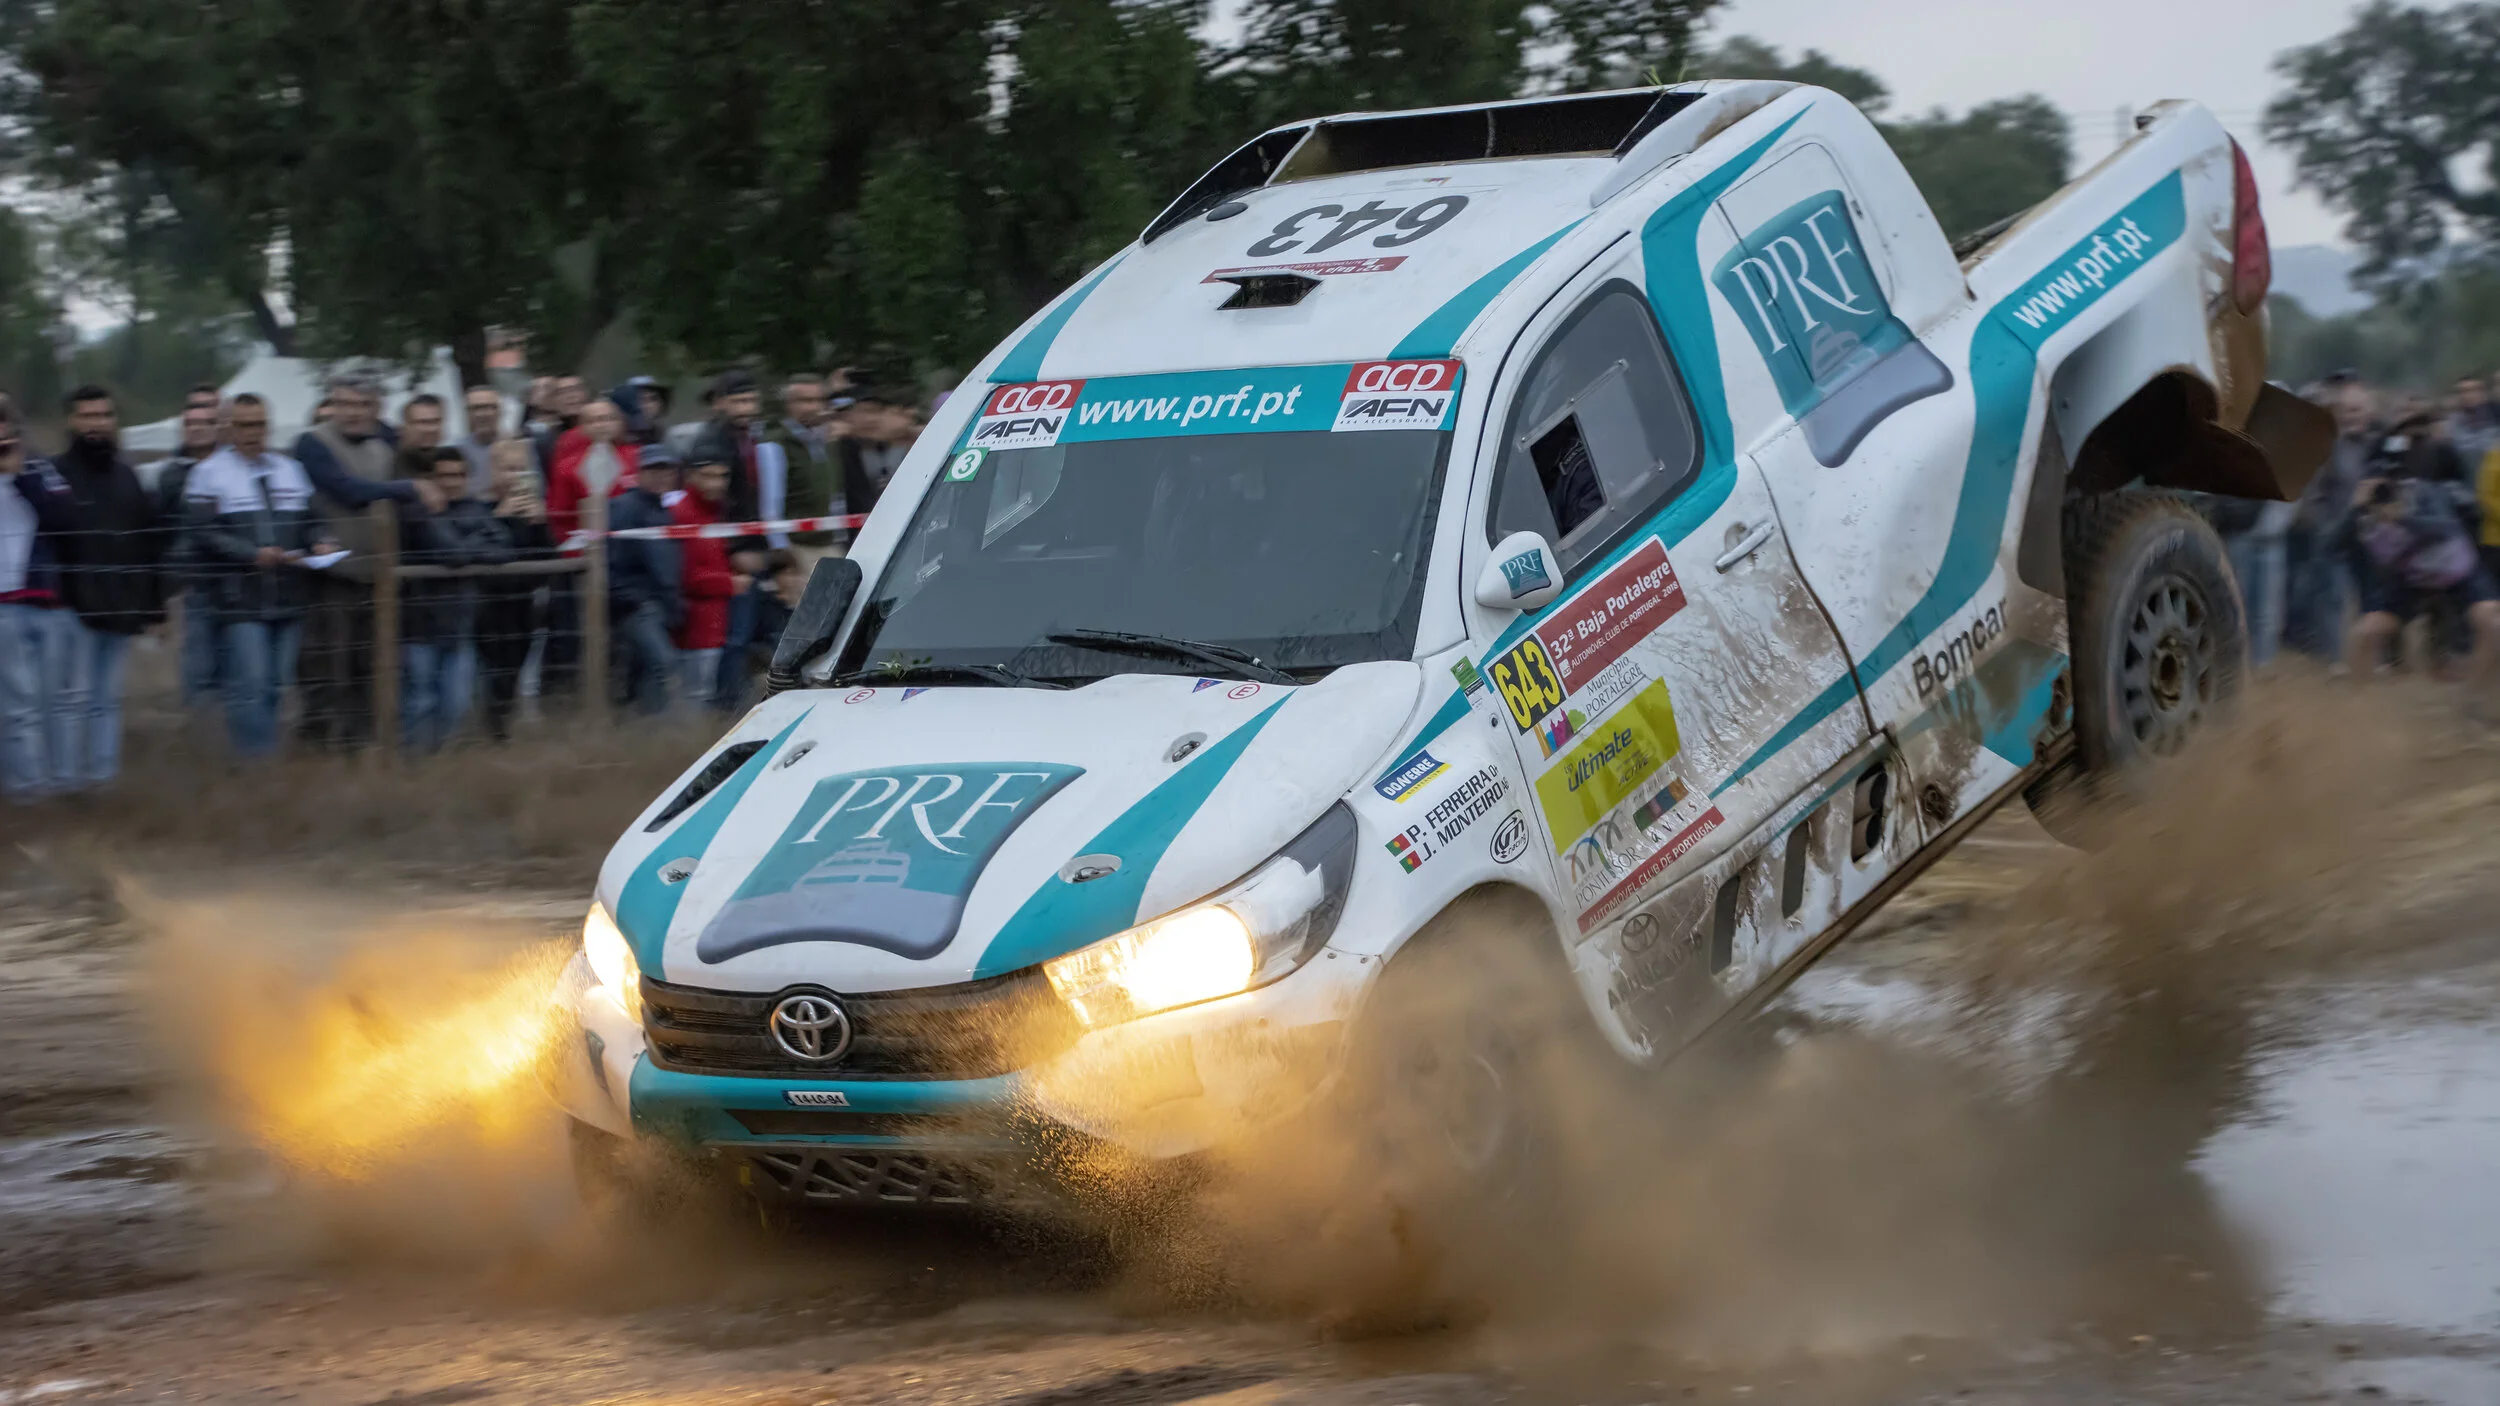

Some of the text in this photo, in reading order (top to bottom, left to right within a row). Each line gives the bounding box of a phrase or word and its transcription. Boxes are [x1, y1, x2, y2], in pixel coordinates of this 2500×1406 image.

[1247, 195, 1470, 257] 643
[1729, 204, 1876, 356] PRF
[2013, 217, 2153, 331] www.prf.pt
[976, 416, 1063, 441] AFN
[1078, 384, 1302, 428] www.prf.pt
[1343, 398, 1445, 418] AFN
[957, 454, 976, 475] 3
[1505, 551, 1540, 580] PRF
[1576, 610, 1607, 640] Baja
[1606, 561, 1671, 617] Portalegre
[1604, 626, 1621, 642] CLUB
[1620, 618, 1630, 630] DE
[1629, 595, 1662, 624] PORTUGAL
[1661, 580, 1679, 597] 2018
[1912, 597, 2008, 699] Bomcar
[1494, 639, 1562, 730] 643
[1585, 662, 1643, 717] PORTALEGRE
[1382, 757, 1436, 797] DONERRE
[1568, 728, 1632, 793] ultimate
[790, 770, 1051, 857] PRF
[1406, 823, 1427, 844] P.
[1424, 769, 1492, 830] FERREIRA
[1423, 841, 1437, 862] J.
[1436, 781, 1504, 848] MONTEIRO
[1651, 800, 1698, 844] avis
[1612, 846, 1646, 872] SOR
[1638, 863, 1661, 887] CLUB
[1660, 853, 1674, 868] DE
[1672, 819, 1718, 859] PORTUGAL
